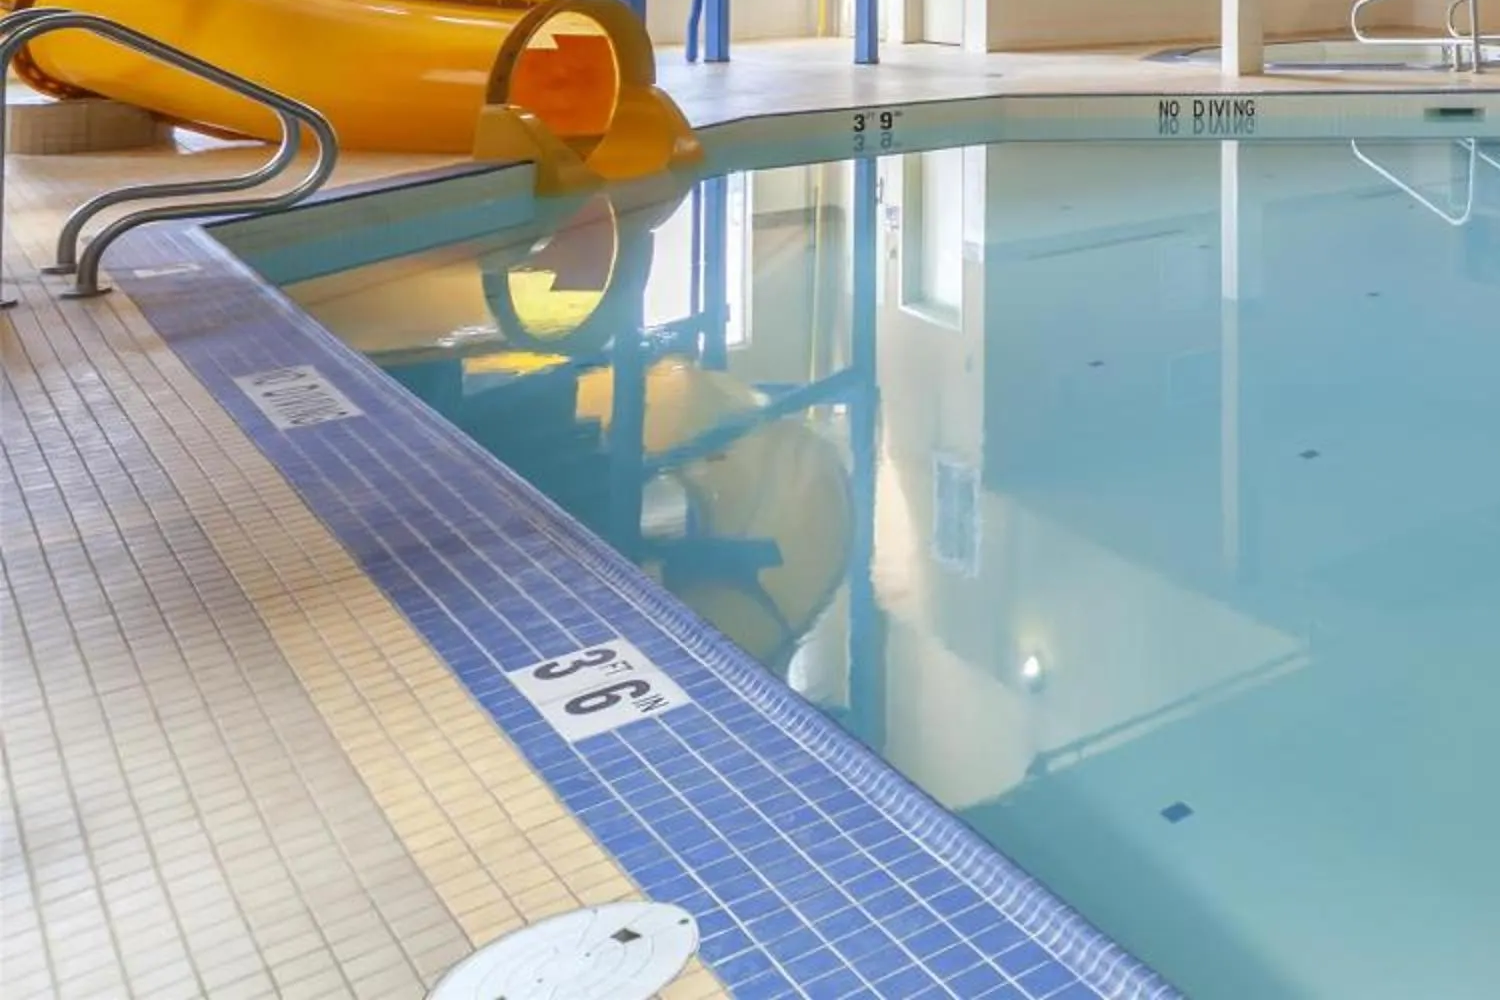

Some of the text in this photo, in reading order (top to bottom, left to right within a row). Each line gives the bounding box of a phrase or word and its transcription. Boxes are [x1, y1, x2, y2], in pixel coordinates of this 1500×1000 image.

[853, 113, 865, 132] 3
[880, 111, 892, 130] 9
[1159, 100, 1255, 117] NO DIVING
[533, 649, 617, 680] 3
[564, 679, 651, 715] 6
